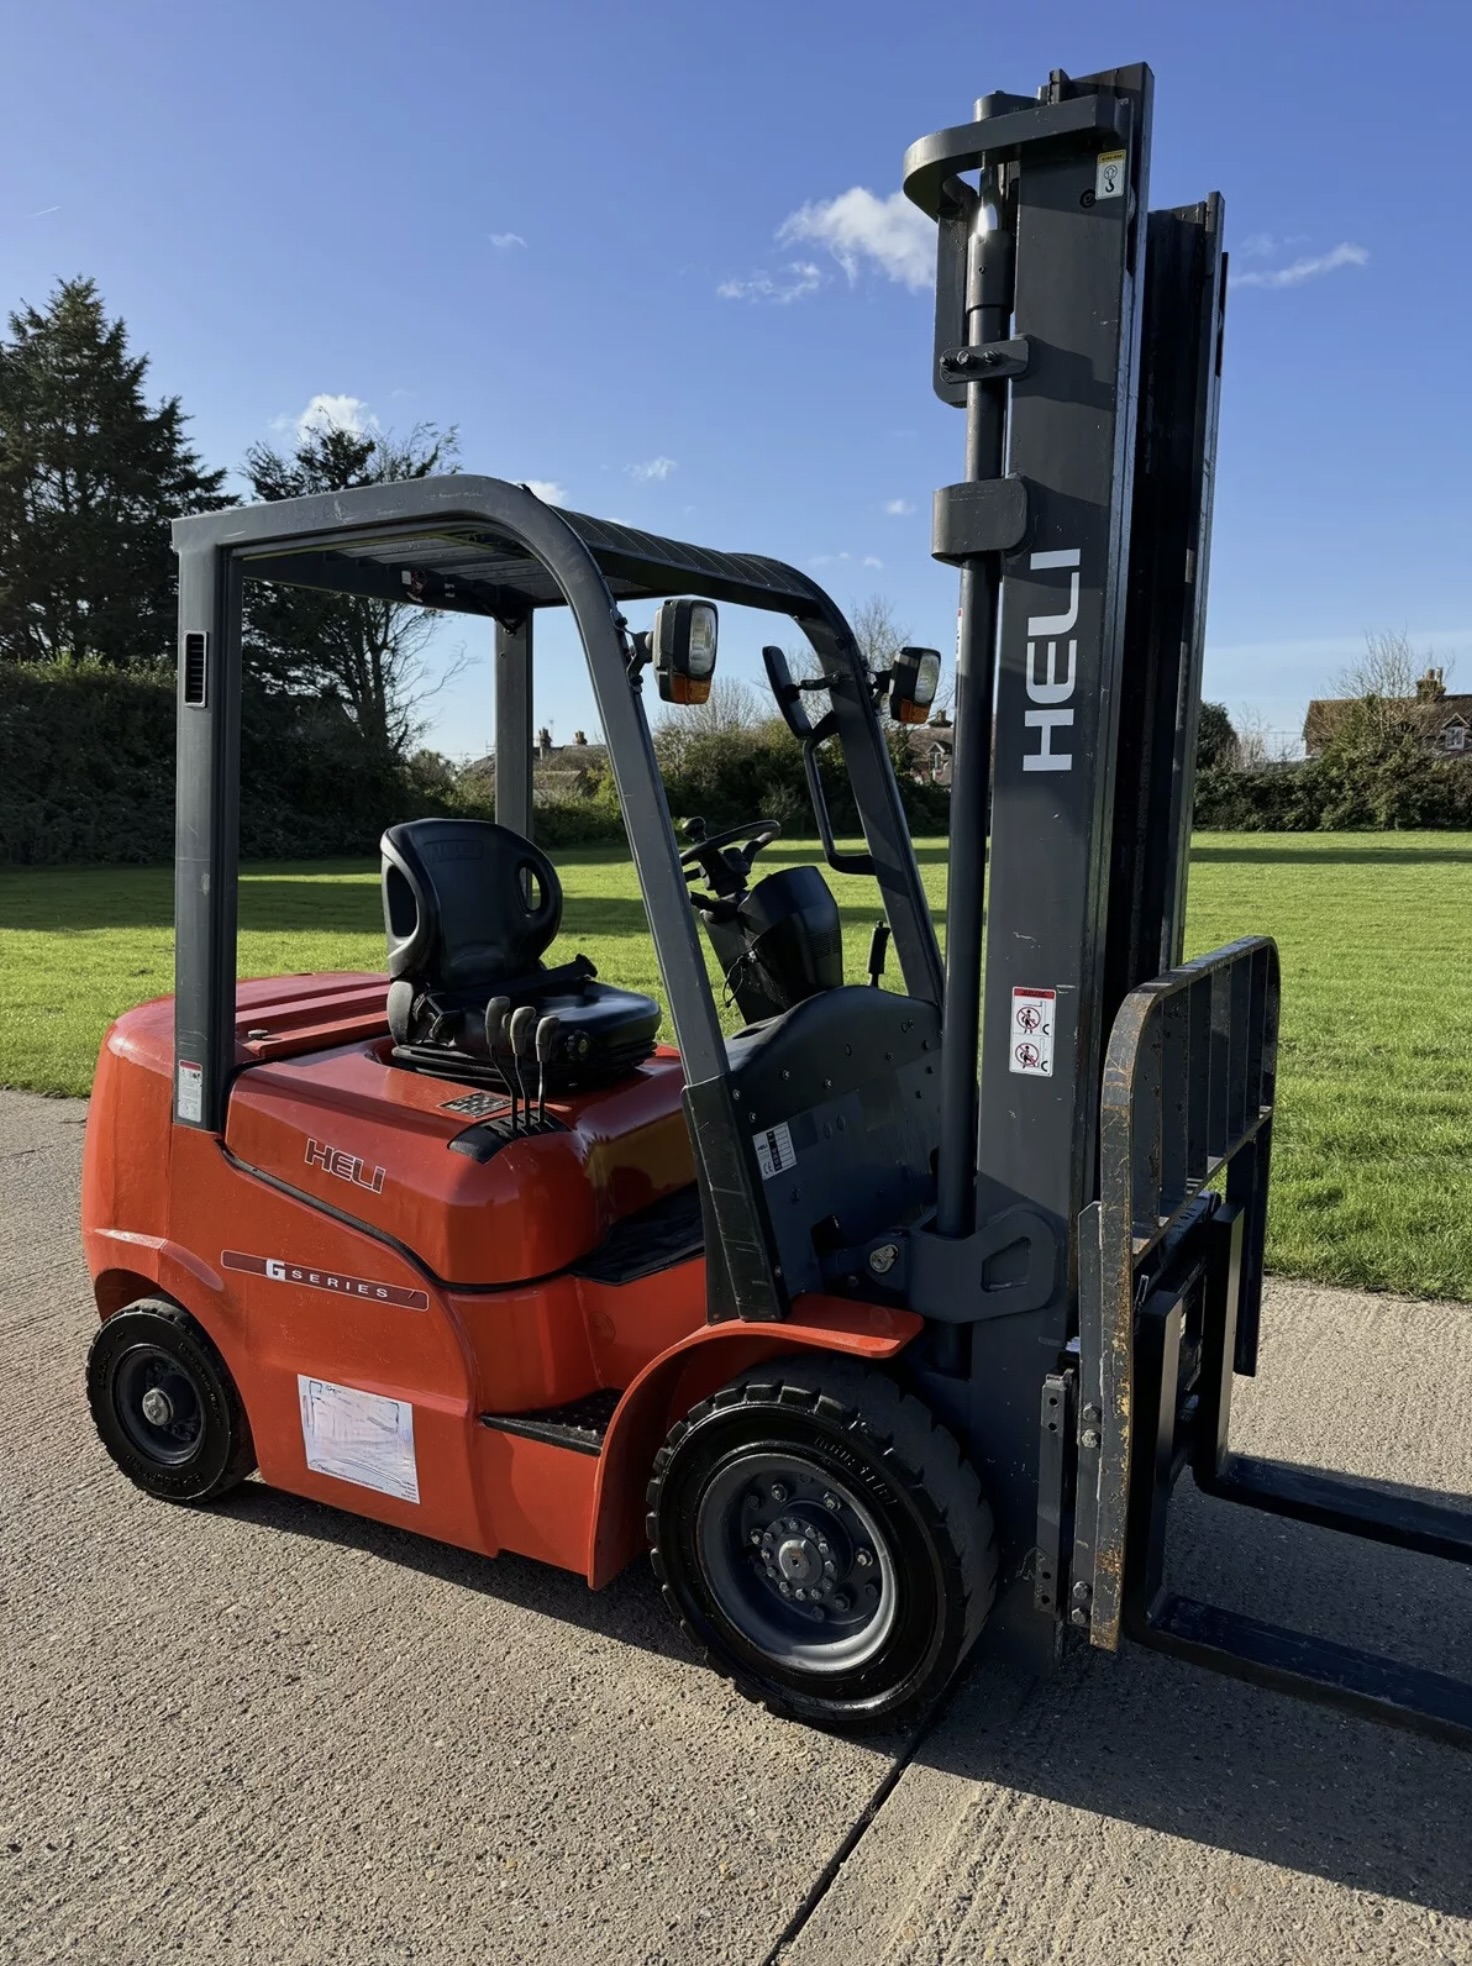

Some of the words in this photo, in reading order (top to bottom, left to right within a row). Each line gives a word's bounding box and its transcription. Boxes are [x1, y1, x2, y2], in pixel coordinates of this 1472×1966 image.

[1022, 548, 1081, 771] HELI
[305, 1138, 386, 1194] HELI
[266, 1258, 286, 1281] G
[291, 1270, 389, 1299] SERIES
